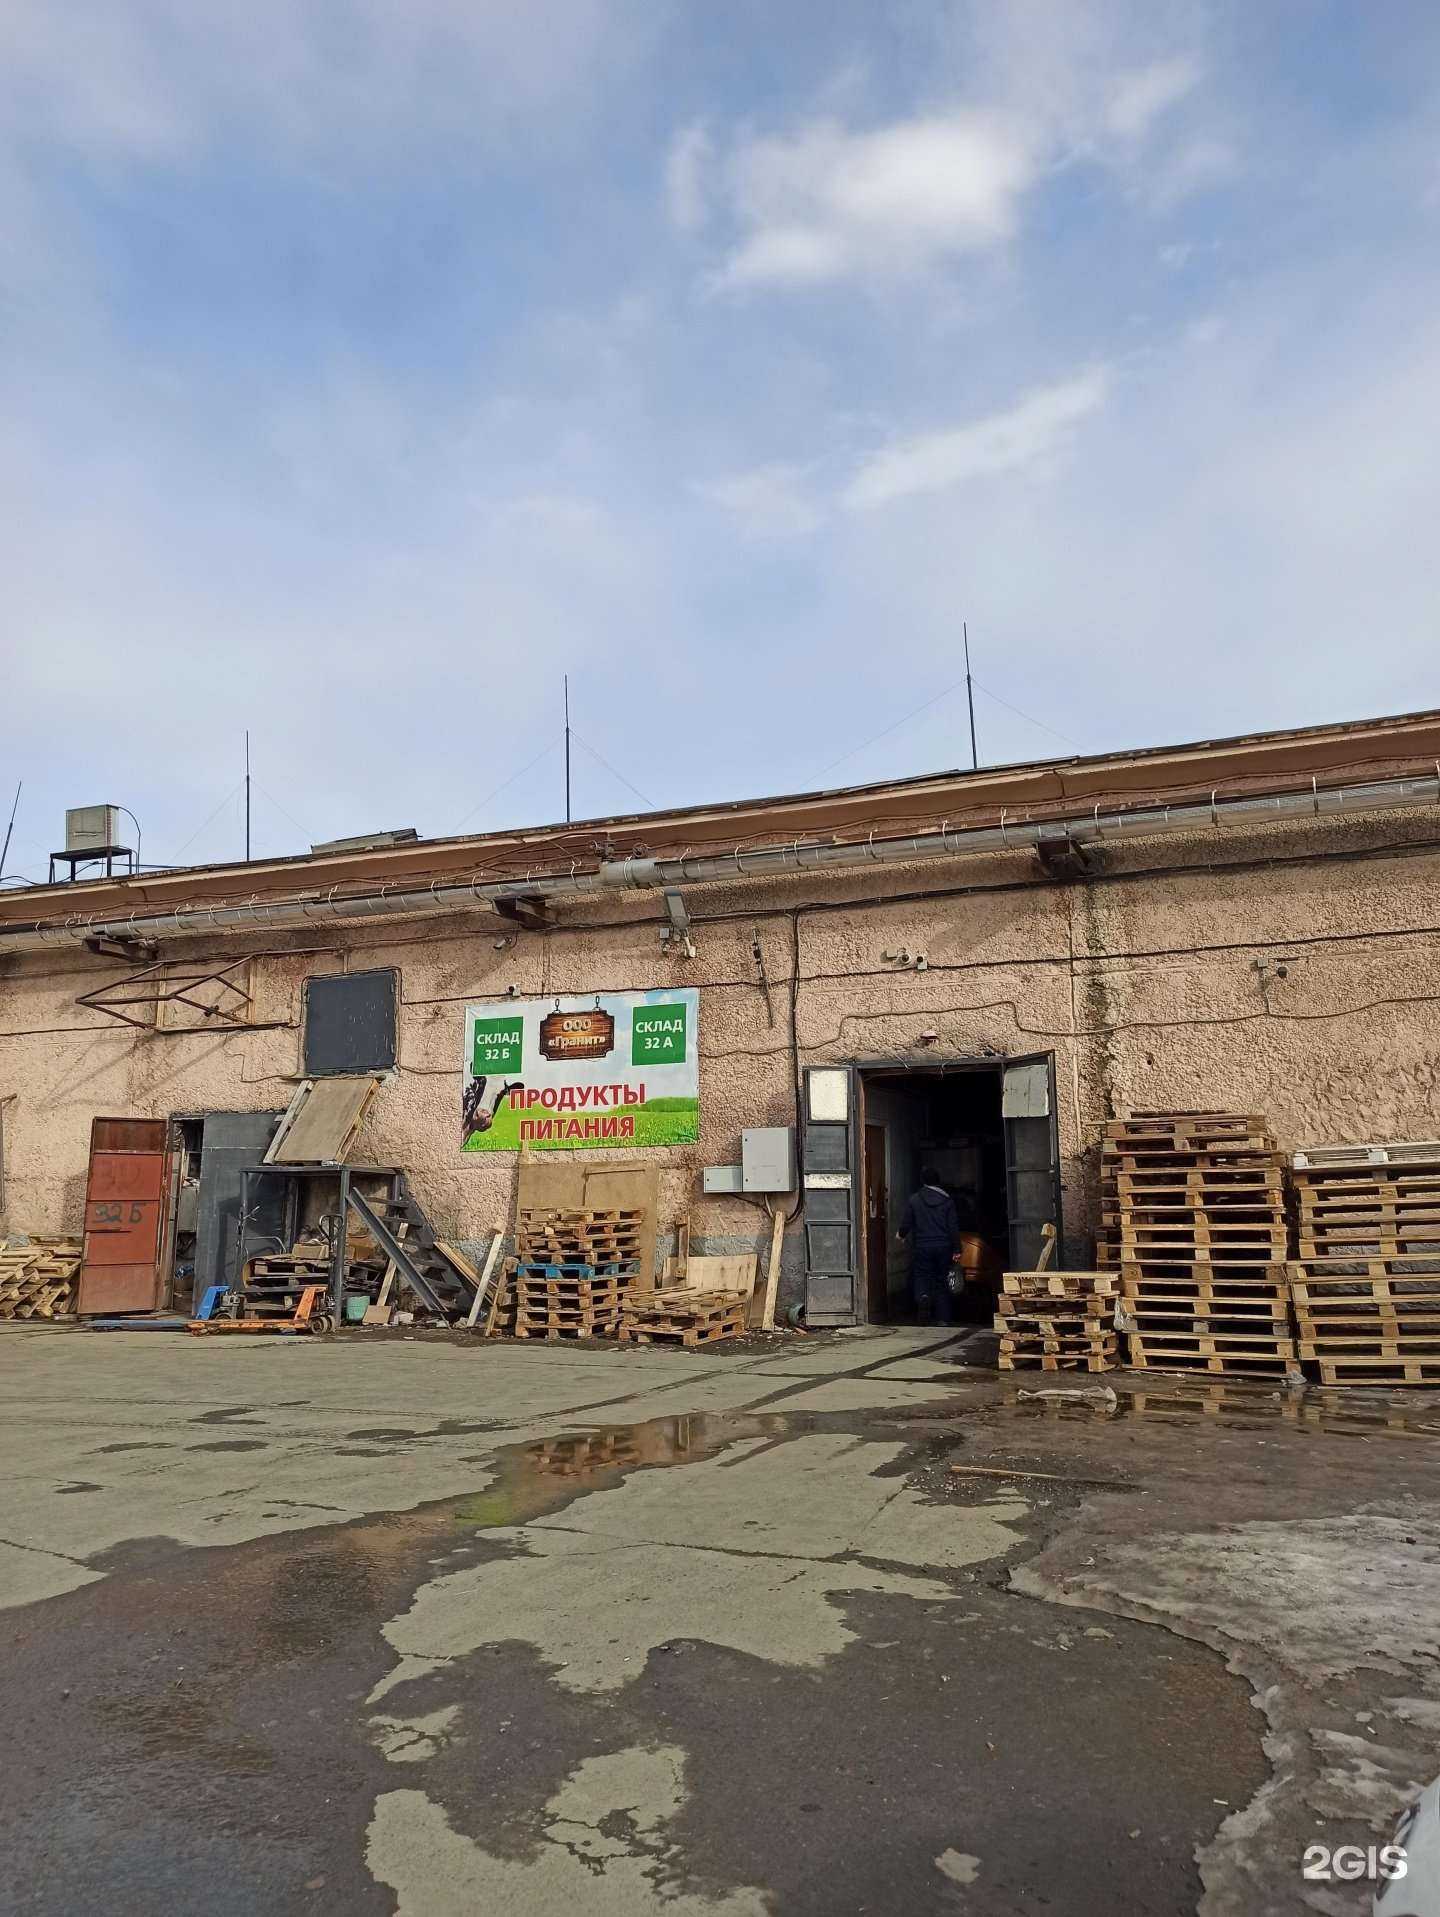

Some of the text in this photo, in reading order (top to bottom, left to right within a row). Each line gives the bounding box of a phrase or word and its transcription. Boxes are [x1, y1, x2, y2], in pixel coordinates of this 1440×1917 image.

[563, 1018, 592, 1032] ООО
[635, 1018, 683, 1033] СКЛАД
[477, 1031, 520, 1045] СКЛАД
[548, 1035, 606, 1049] «Гранит»
[644, 1036, 673, 1049] 32 А
[485, 1047, 510, 1060] 32 Б
[510, 1083, 646, 1112] ПРОДУКТЫ
[519, 1115, 635, 1141] ПИТАНИЯ
